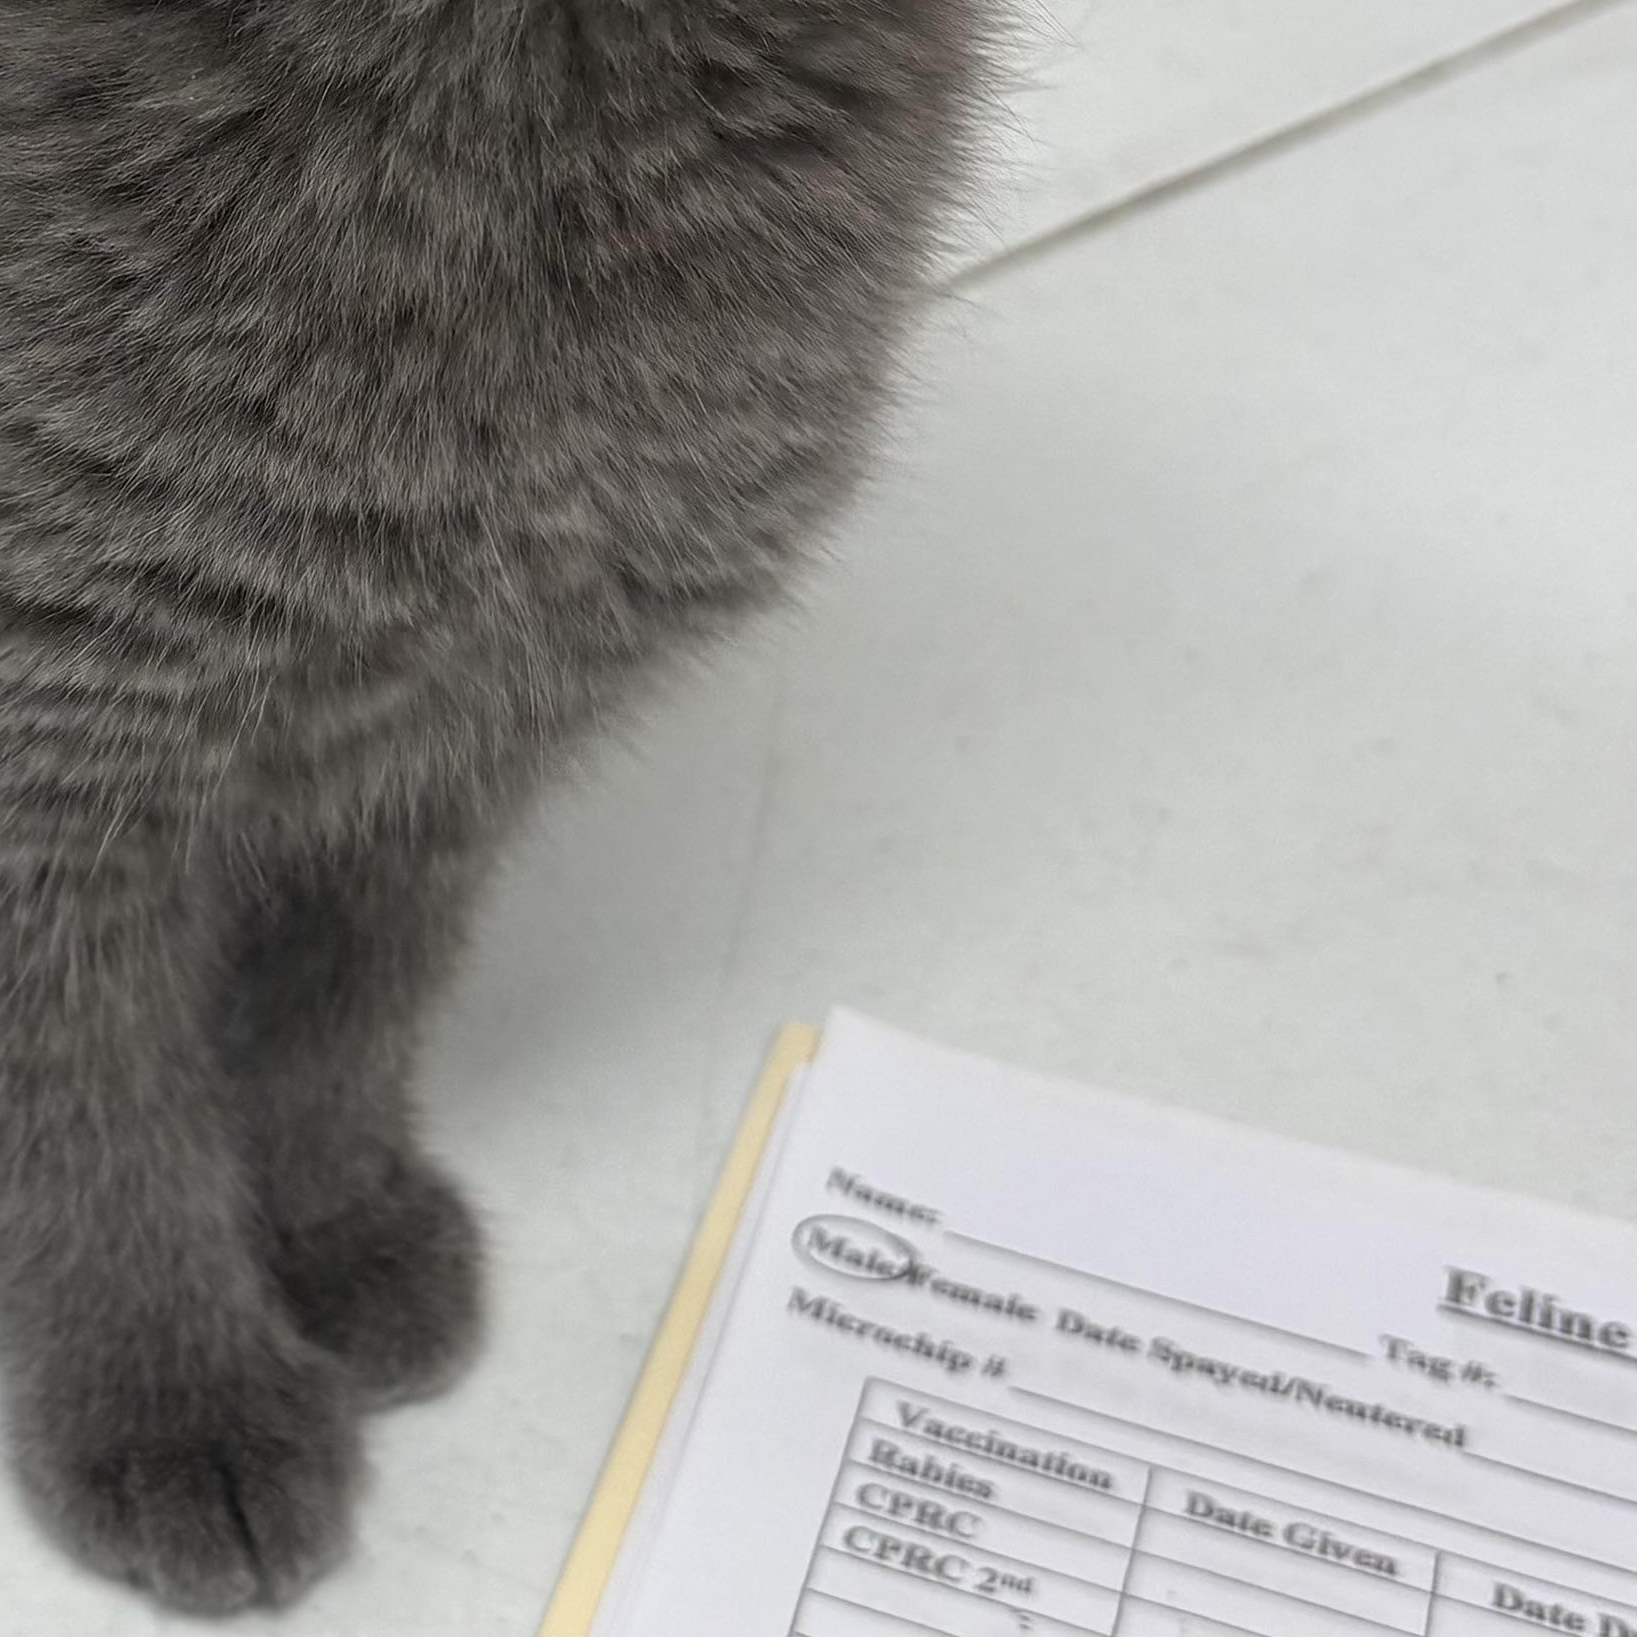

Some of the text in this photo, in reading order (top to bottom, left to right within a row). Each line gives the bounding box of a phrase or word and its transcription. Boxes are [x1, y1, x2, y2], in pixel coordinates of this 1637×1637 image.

[786, 1285, 1008, 1379] Microchip #
[1443, 1265, 1635, 1351] Feline
[1056, 1307, 1142, 1353] Date
[1146, 1336, 1471, 1448] Spayed/Neutered
[1377, 1332, 1455, 1384] Tag
[866, 1436, 997, 1500] Rabies
[895, 1399, 1116, 1491] Vaccination
[854, 1480, 985, 1539] CPRC
[1182, 1489, 1400, 1578] Date Given
[842, 1523, 972, 1584] CPRC
[1492, 1581, 1585, 1632] Date
